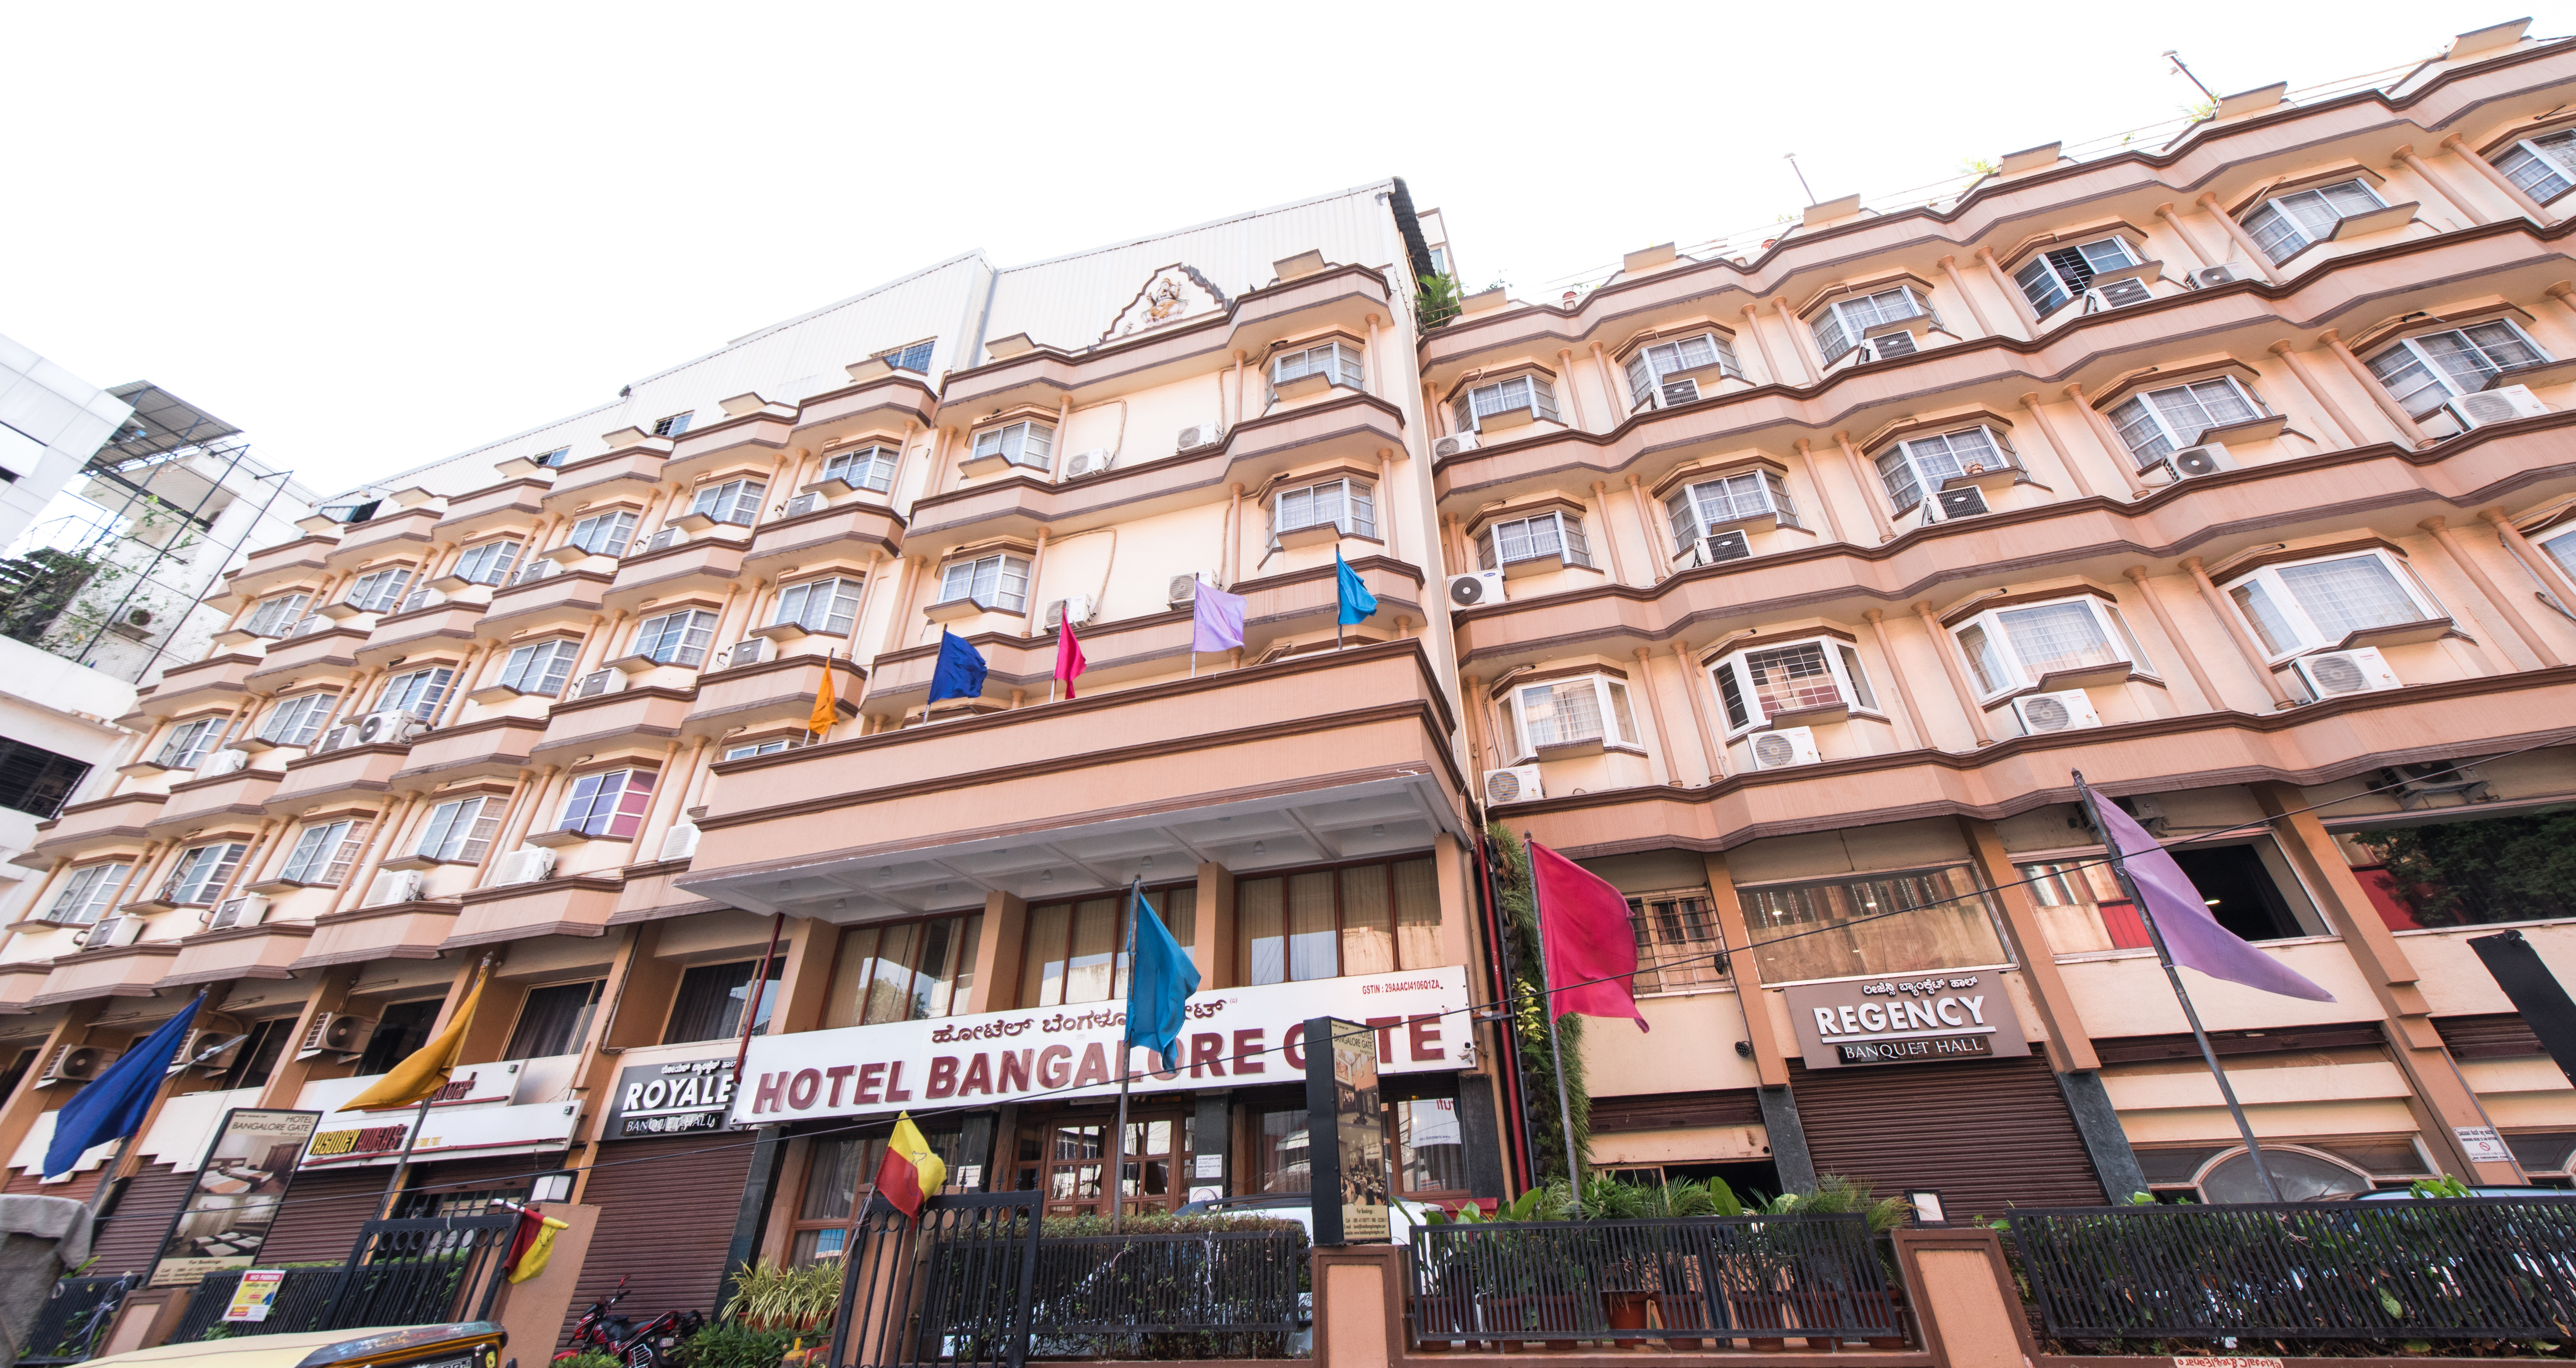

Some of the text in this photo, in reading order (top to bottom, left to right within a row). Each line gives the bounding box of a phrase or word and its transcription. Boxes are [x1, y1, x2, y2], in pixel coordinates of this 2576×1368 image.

[1363, 985, 1380, 995] GSTIN
[1385, 980, 1440, 992] 29AAACI4106Q1ZA
[1949, 976, 1978, 988] ಹಾಲ್
[1813, 995, 1984, 1035] REGENCY
[932, 1018, 1035, 1043] ಹೋಟೆಲ್
[1042, 1008, 1127, 1032] ಬೆಂಗಳೂ
[1358, 1029, 1372, 1040] HOTEL
[1334, 1033, 1372, 1050] BANGALORE GATE
[1845, 1039, 1983, 1059] BANQUET HALL
[752, 1013, 1446, 1114] HOTEL BANGALORE GTE
[622, 1074, 734, 1110] ROYALE
[232, 1122, 286, 1130] BANGALORE
[626, 1115, 712, 1132] BANQUET HALL
[308, 1129, 362, 1155] VASUDEV
